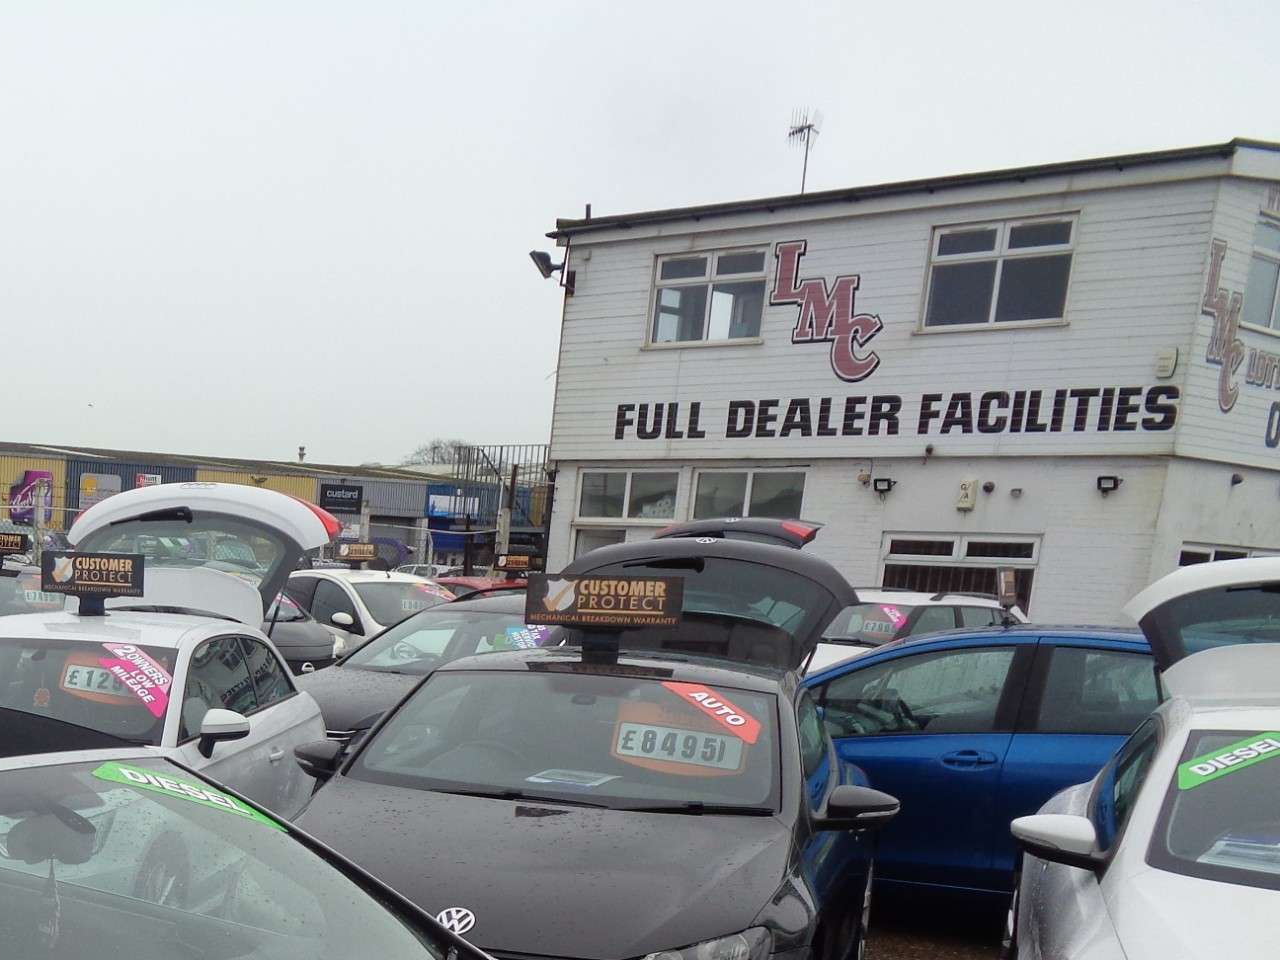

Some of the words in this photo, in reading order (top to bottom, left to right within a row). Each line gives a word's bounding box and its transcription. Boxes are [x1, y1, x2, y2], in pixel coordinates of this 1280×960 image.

[770, 239, 883, 383] LMC
[615, 401, 706, 440] FULL
[725, 394, 903, 438] DEALER
[917, 385, 1180, 435] FACILITIES
[326, 489, 359, 499] custard
[75, 557, 133, 571] CUSTOMER
[74, 570, 133, 582] PROTECT
[579, 579, 667, 597] CUSTOMER
[577, 596, 667, 610] PROTECT
[531, 613, 581, 622] MECHANICAL
[582, 615, 631, 624] BREAKDOWN
[633, 617, 677, 625] WARRANTY
[112, 645, 129, 657] 2
[127, 654, 168, 687] OWNERS
[111, 666, 154, 703] MILEAGE
[133, 670, 156, 689] LOW
[689, 691, 747, 726] AUTO
[119, 767, 254, 816] DIESEL
